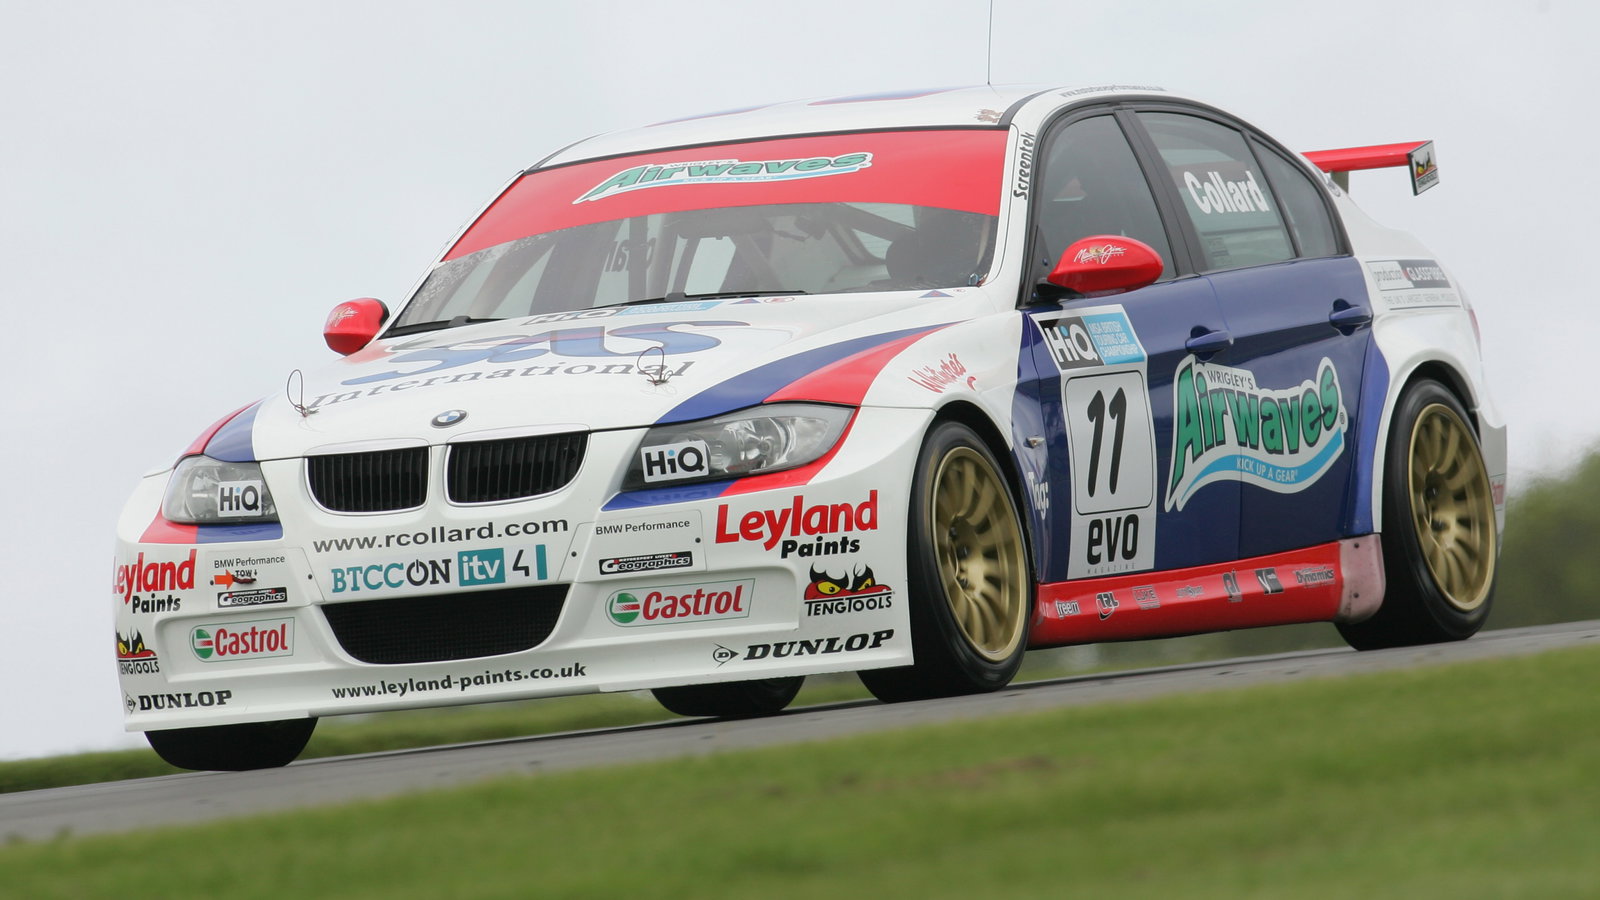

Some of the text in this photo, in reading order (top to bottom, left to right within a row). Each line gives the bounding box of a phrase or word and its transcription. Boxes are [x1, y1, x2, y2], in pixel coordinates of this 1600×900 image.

[577, 153, 870, 201] Airwaves
[1013, 131, 1035, 201] Screentek
[1184, 170, 1269, 214] Collard
[1044, 324, 1098, 362] HiQ
[307, 361, 695, 409] International
[1207, 370, 1254, 391] WRIGLEY'S
[1087, 387, 1127, 498] 11
[1168, 363, 1339, 500] Airwaves
[645, 446, 705, 477] HiQ
[1236, 457, 1254, 472] KICK
[1256, 463, 1268, 476] UP
[1275, 469, 1298, 483] GEAR
[219, 485, 260, 512] HiQ
[313, 518, 569, 553] www.rcollard.com
[596, 520, 690, 535] BMW Performance
[715, 489, 878, 551] Leyland
[781, 535, 861, 559] Paints
[1087, 514, 1140, 565] evo
[214, 556, 286, 569] BMW Performance
[235, 569, 253, 578] TOW
[461, 554, 503, 582] itv
[512, 549, 530, 577] 4
[601, 556, 691, 573] Geographics
[132, 592, 181, 614] Paints
[219, 592, 287, 607] Geographics
[642, 584, 743, 621] Castrol
[215, 623, 288, 657] Castrol
[743, 629, 895, 661] DUNLOP
[332, 662, 586, 699] www.leyland-paints.co.uk
[138, 689, 232, 711] DUNLOP
